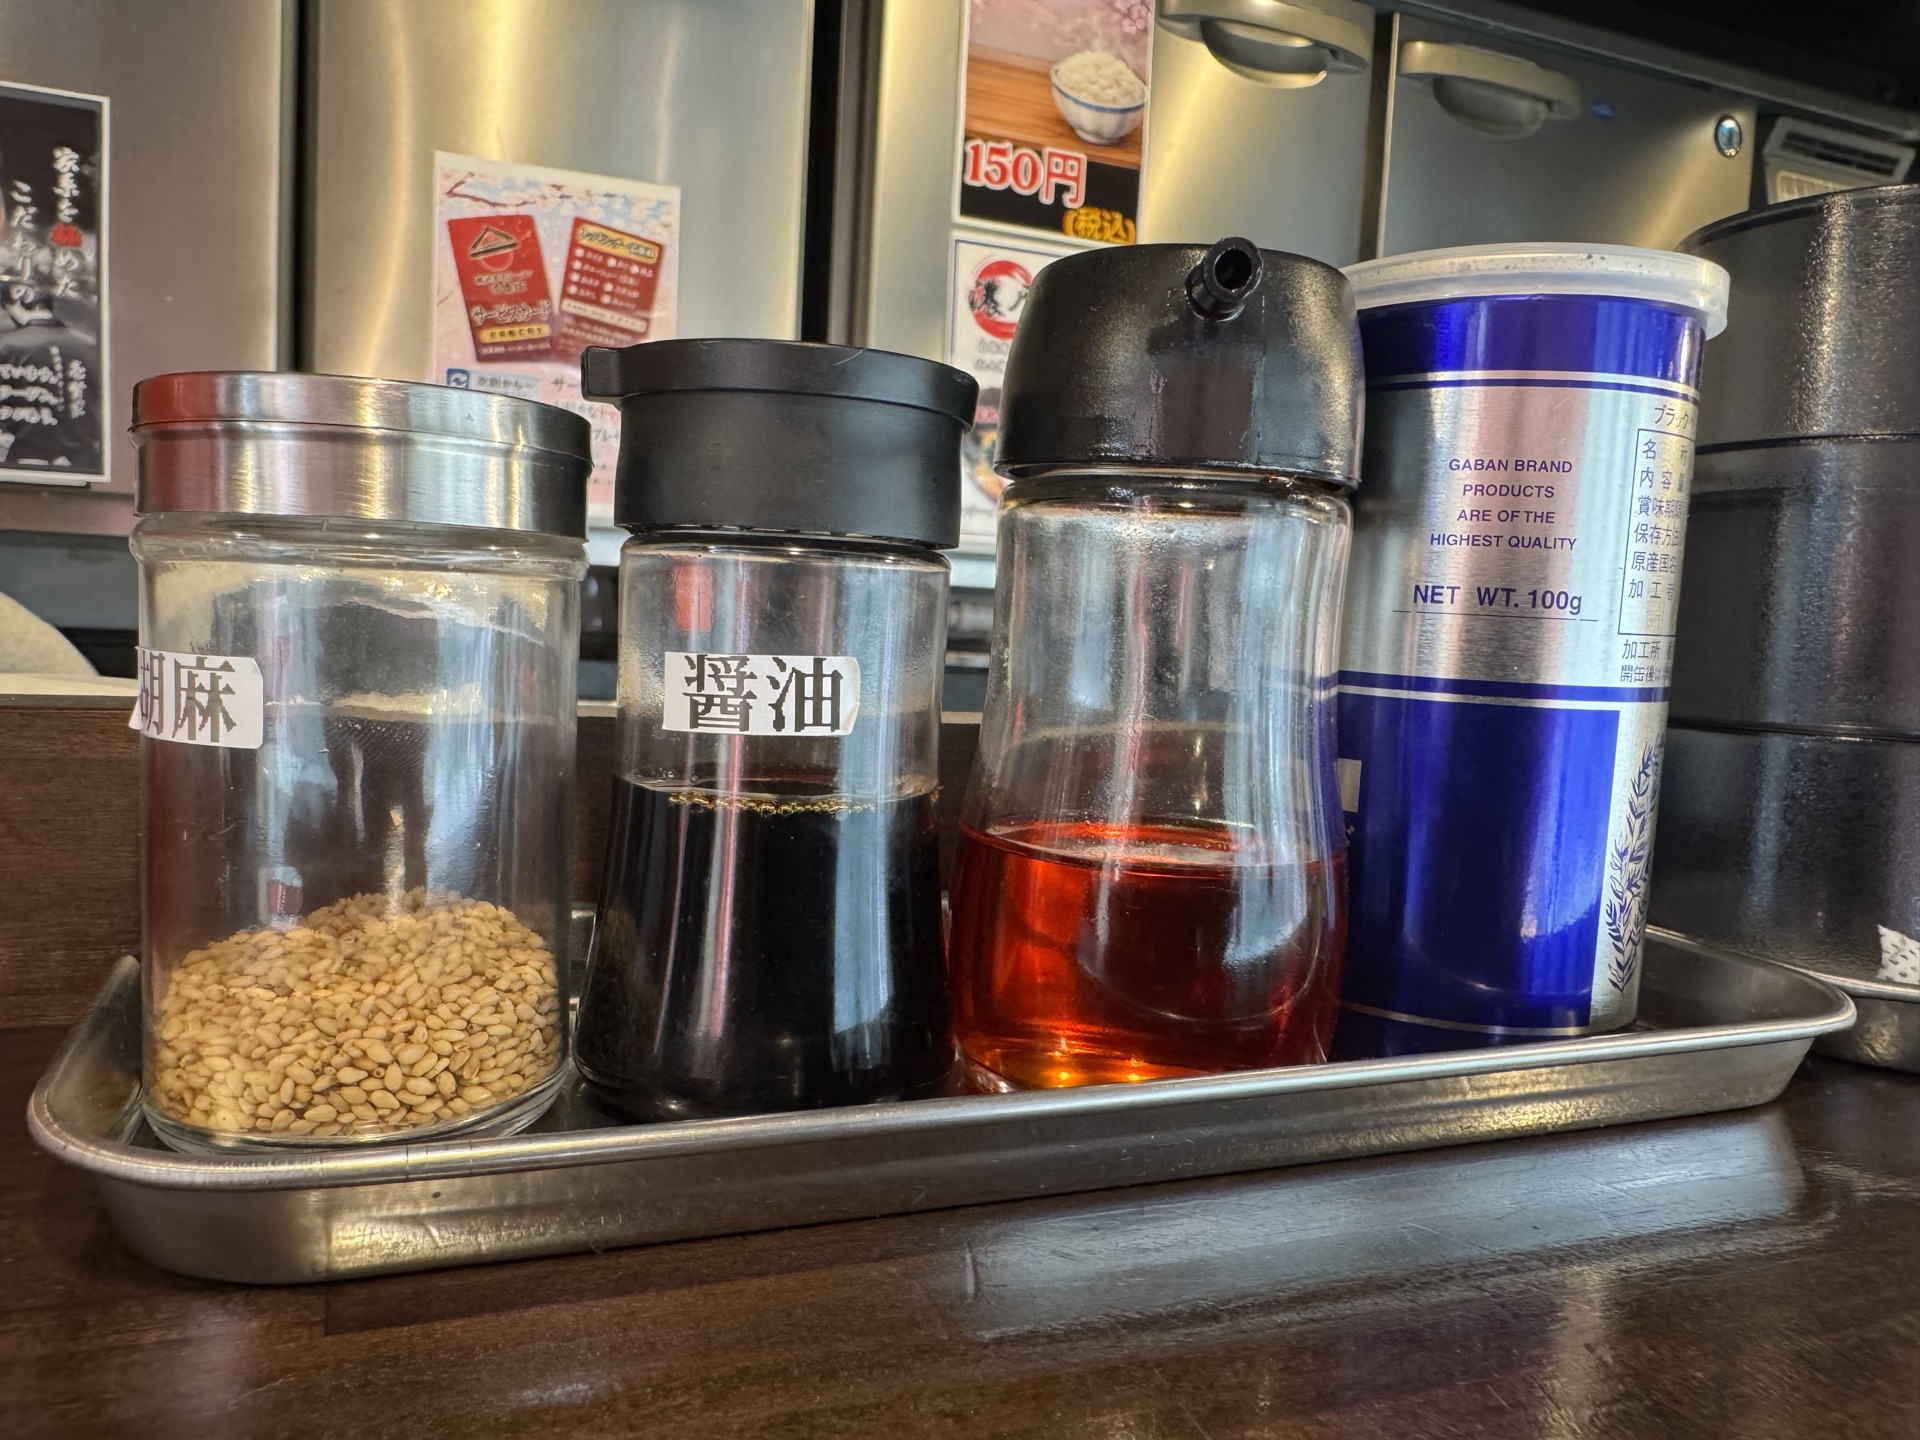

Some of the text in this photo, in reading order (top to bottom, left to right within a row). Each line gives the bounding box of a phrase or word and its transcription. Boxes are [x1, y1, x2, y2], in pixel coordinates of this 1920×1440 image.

[964, 138, 1088, 208] 150円
[1448, 458, 1573, 474] GABAN BRAND
[1462, 484, 1555, 499] PRODUCTS
[1456, 509, 1556, 524] ARE OF THE
[1429, 533, 1578, 550] HIGHEST QUALITY
[1413, 584, 1583, 616] NET WT. 100g
[140, 650, 237, 744] 胡麻
[682, 653, 844, 733] 醤油
